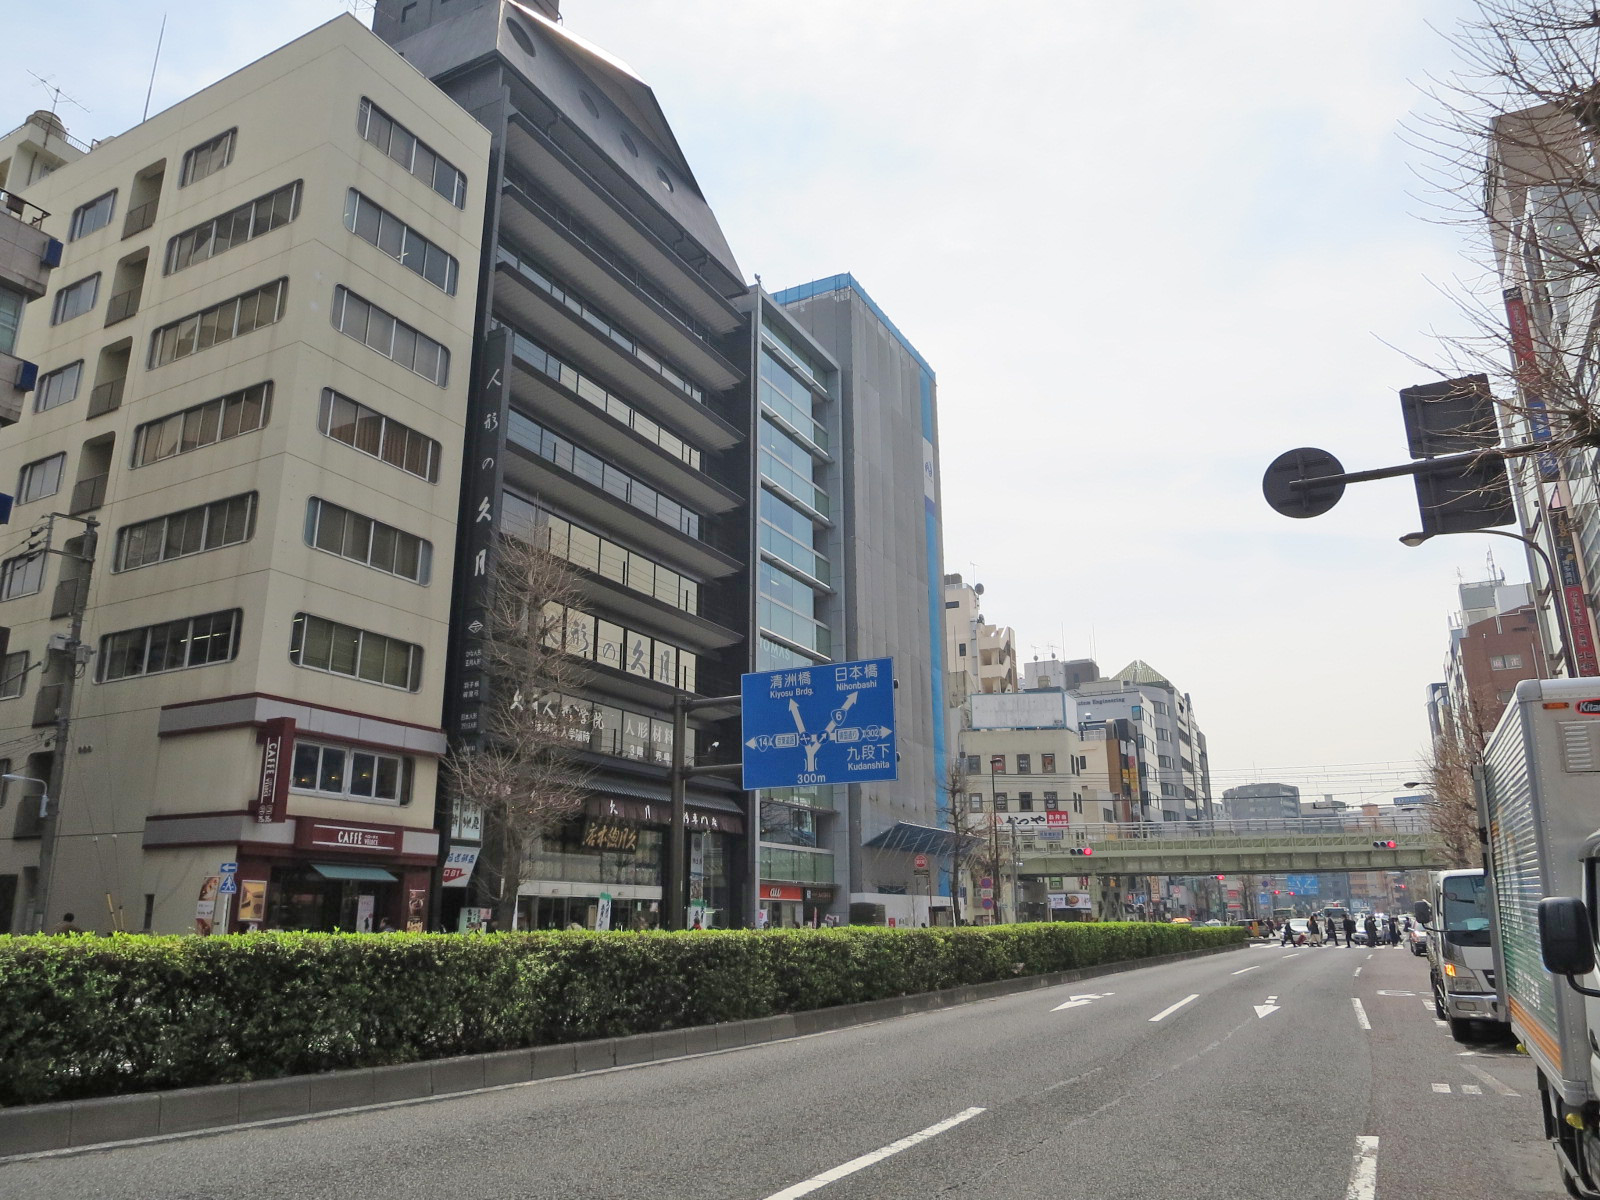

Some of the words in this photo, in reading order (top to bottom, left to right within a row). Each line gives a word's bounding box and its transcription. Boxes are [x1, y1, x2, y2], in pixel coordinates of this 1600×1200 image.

[474, 368, 503, 577] 人形の久月
[835, 663, 878, 682] 日本橋
[770, 671, 811, 689] 清洲橋
[836, 680, 877, 692] Nihonbashi
[770, 690, 794, 700] Kiyosu
[795, 687, 814, 697] Brdg.
[835, 711, 842, 721] 6
[866, 729, 879, 737] 302
[758, 739, 768, 747] 14
[847, 744, 891, 761] 九段下
[847, 761, 890, 771] Kudanshita
[797, 774, 826, 784] 300m
[769, 887, 782, 898] au
